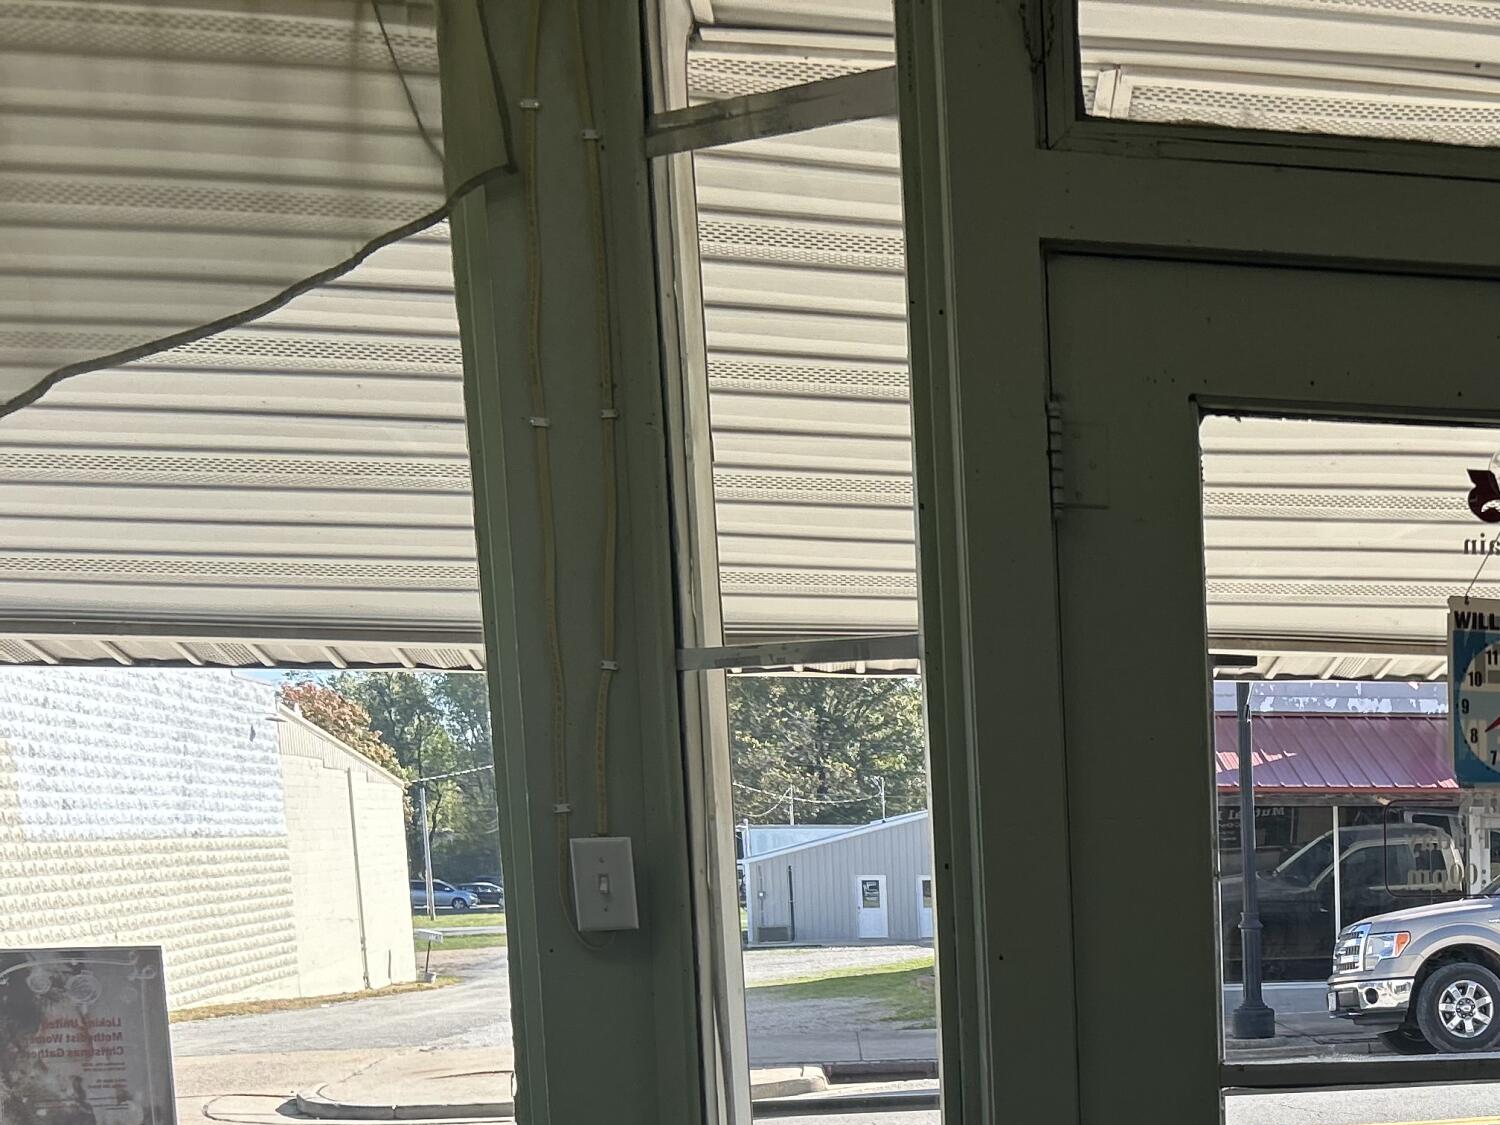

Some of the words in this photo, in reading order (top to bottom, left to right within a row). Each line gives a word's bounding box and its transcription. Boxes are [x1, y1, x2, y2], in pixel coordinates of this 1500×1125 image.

[1454, 611, 1500, 631] WILL
[1486, 650, 1499, 665] 11
[1468, 671, 1483, 687] 10
[1461, 698, 1470, 714] 9
[1470, 728, 1479, 744] 8
[1490, 751, 1498, 765] 7
